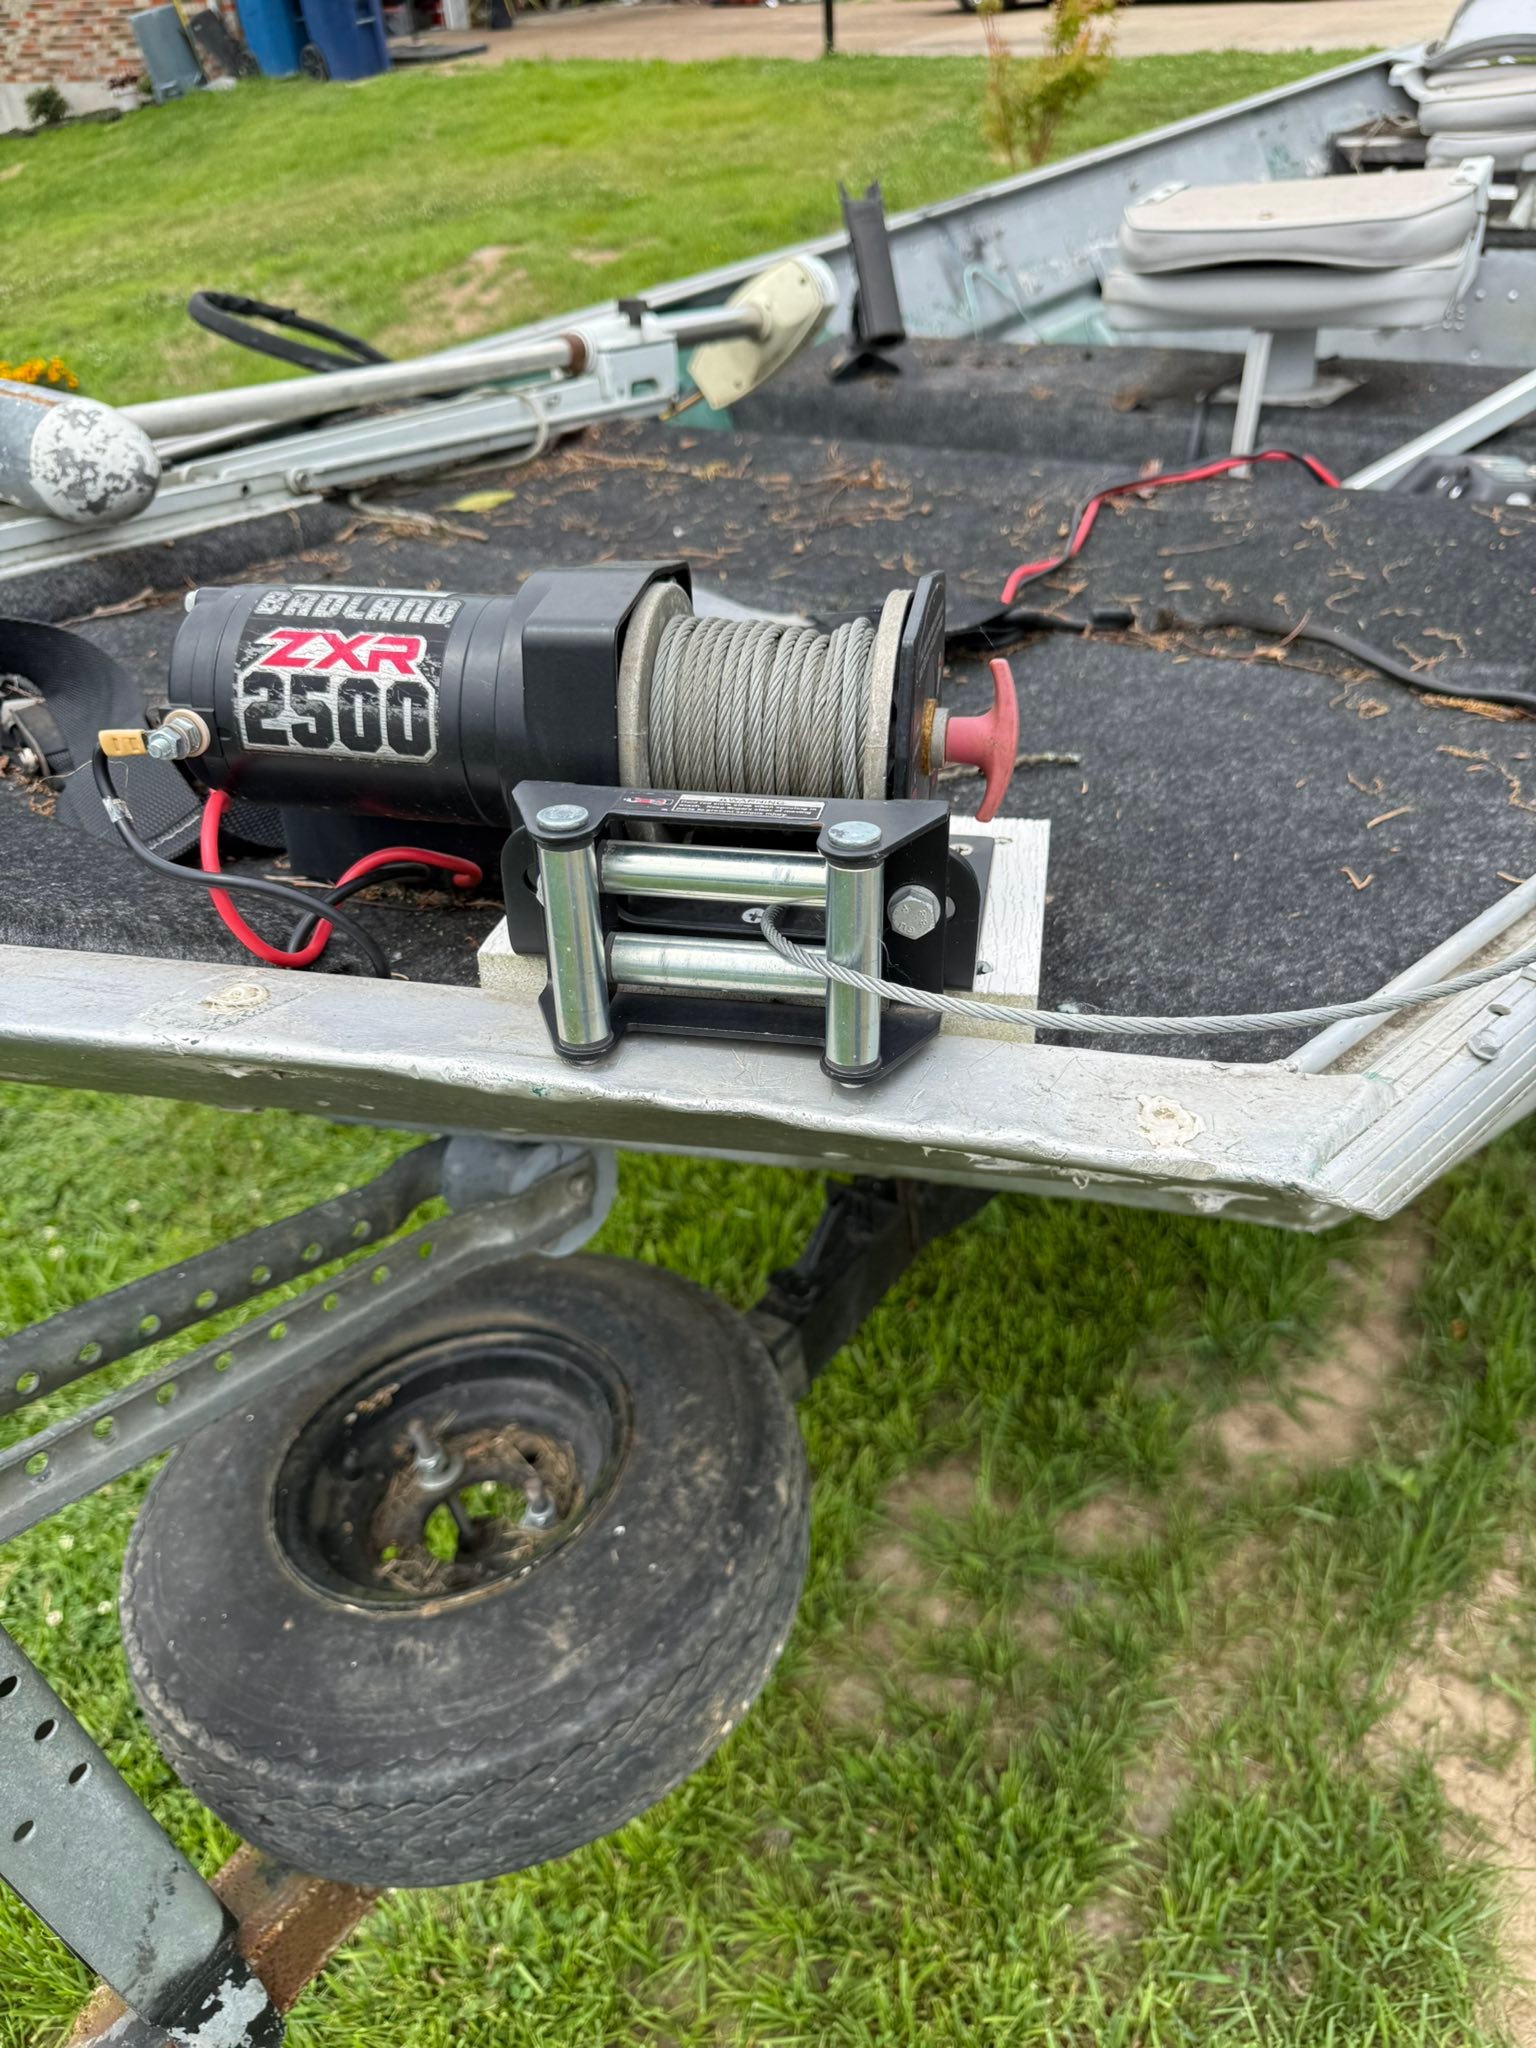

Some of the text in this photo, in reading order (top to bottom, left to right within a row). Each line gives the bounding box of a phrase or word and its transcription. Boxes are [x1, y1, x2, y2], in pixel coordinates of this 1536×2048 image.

[253, 590, 462, 625] BADLAND
[257, 628, 420, 676] ZXR
[241, 670, 434, 758] 2500
